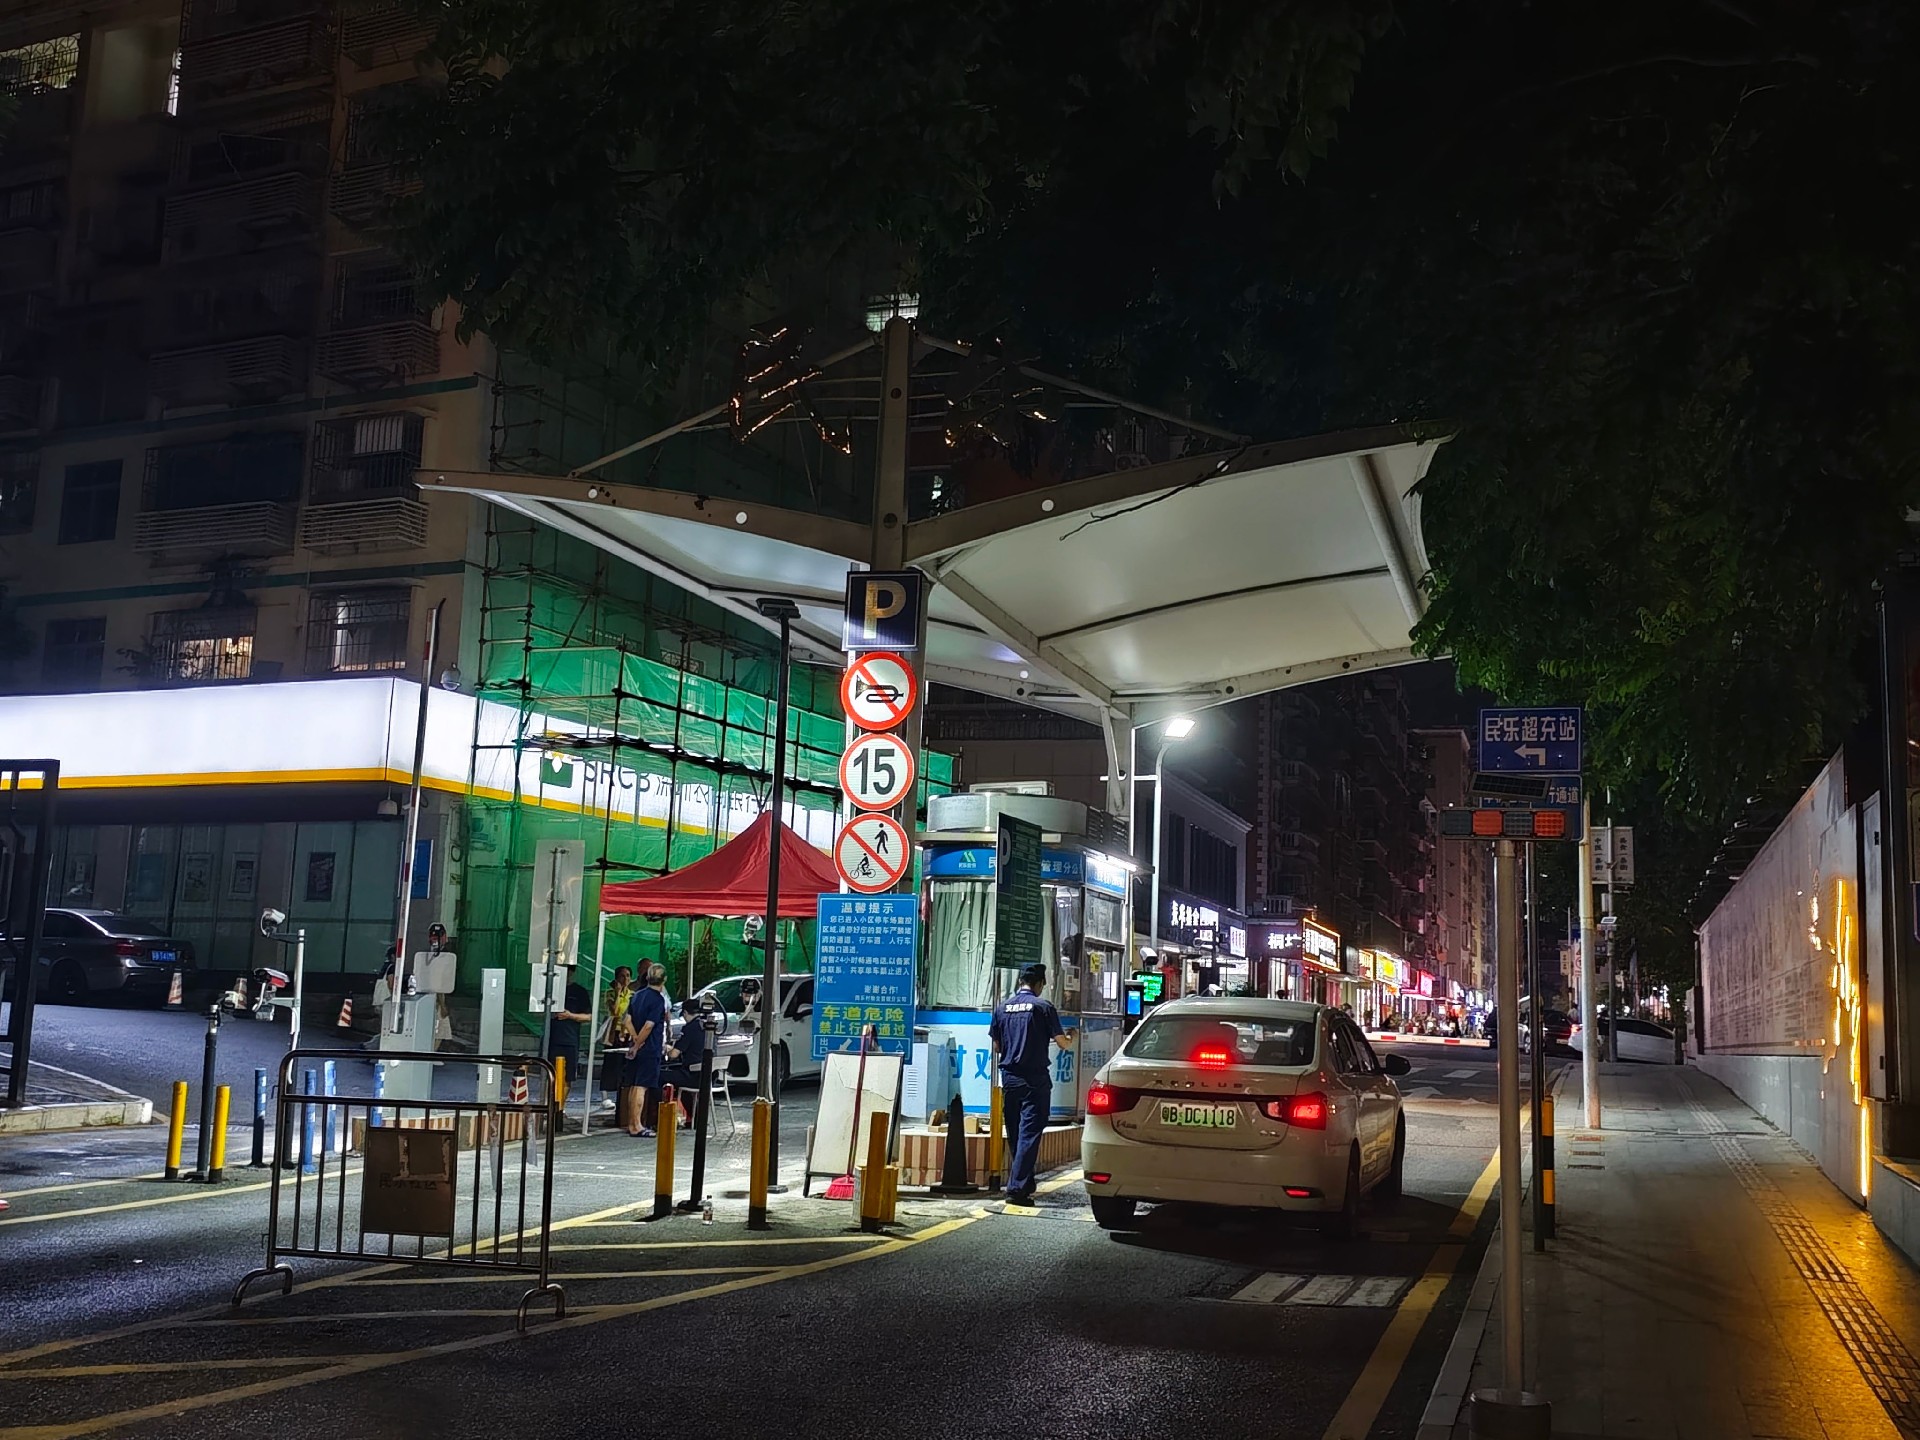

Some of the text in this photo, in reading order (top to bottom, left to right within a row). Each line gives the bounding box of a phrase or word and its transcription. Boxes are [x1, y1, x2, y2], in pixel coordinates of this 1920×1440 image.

[863, 580, 906, 639] P
[1485, 716, 1576, 741] 民乐超充站
[853, 748, 896, 795] 15
[841, 902, 894, 914] 温馨提示
[821, 1005, 904, 1022] 车道危险
[819, 1021, 906, 1036] 禁止行通过
